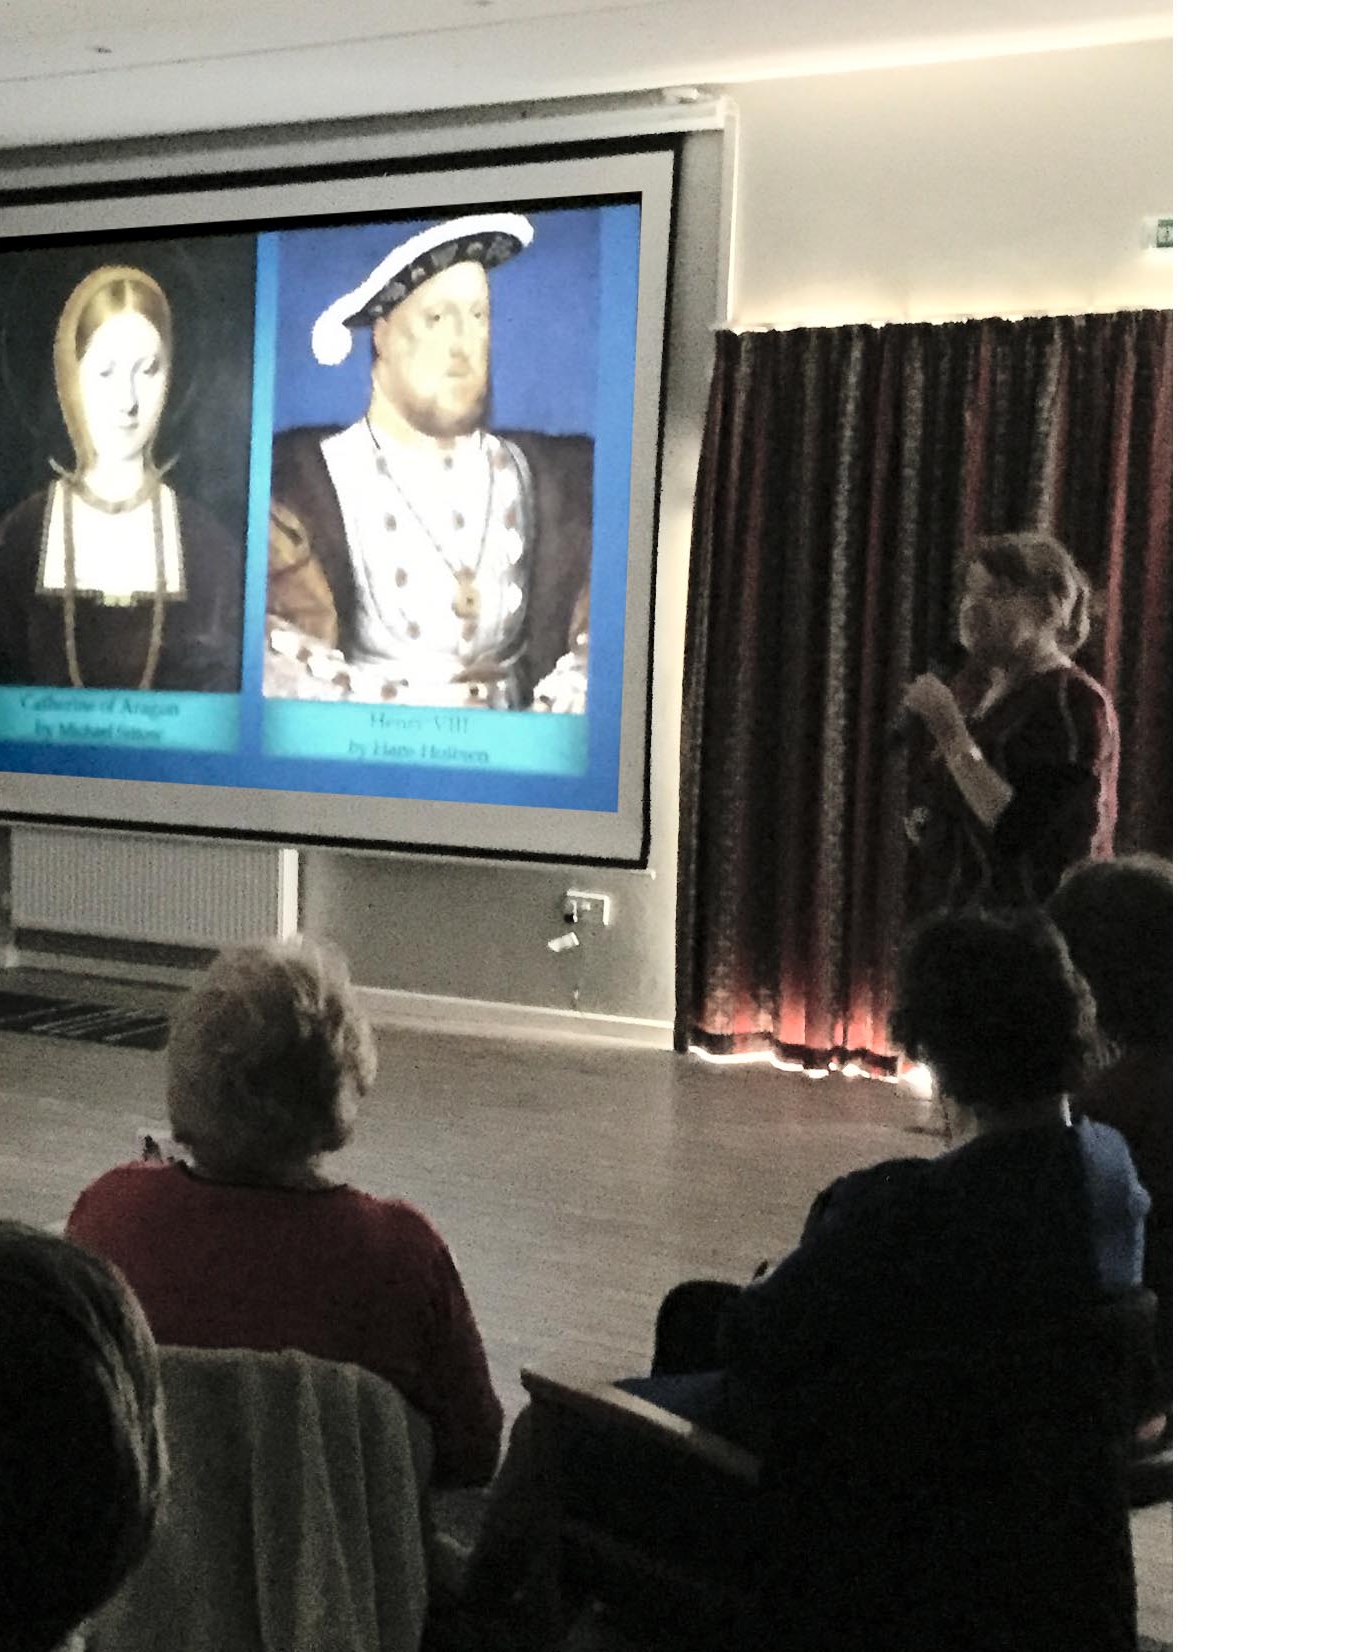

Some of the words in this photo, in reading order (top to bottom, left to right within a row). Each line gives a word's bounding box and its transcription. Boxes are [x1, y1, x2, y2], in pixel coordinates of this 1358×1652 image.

[99, 696, 116, 712] of
[120, 697, 180, 718] Aragon
[34, 718, 53, 739] by
[434, 716, 469, 734] VIII
[348, 739, 367, 759] by
